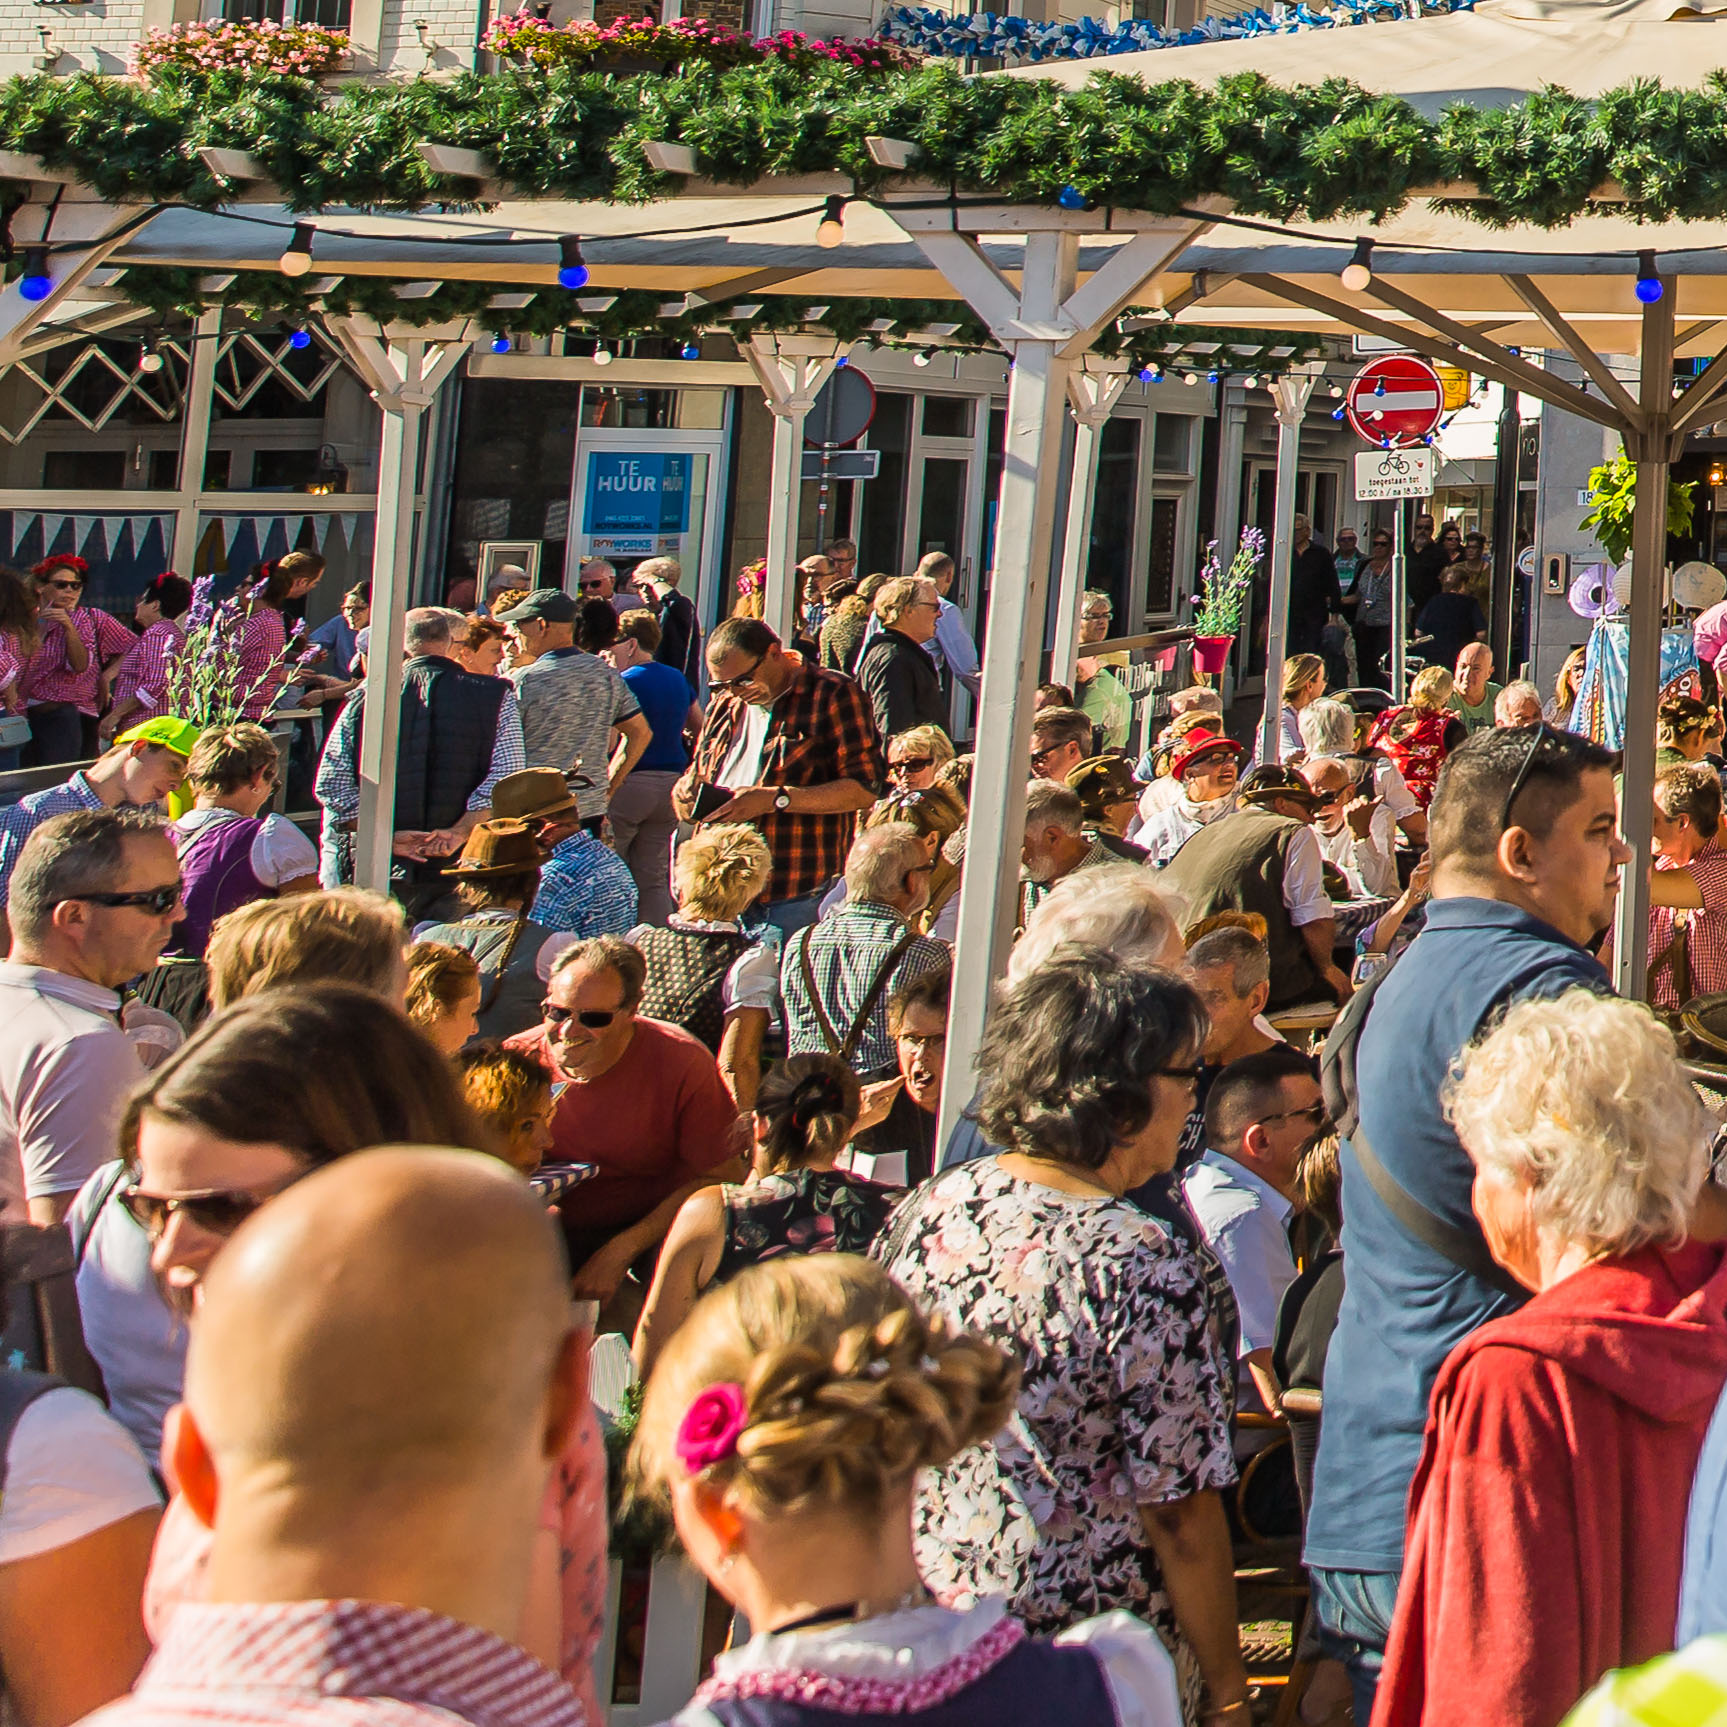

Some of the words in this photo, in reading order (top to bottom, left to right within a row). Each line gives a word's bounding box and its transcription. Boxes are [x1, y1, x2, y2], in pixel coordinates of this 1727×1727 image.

[618, 460, 641, 476] TE
[598, 476, 657, 492] HUUR
[1369, 477, 1407, 488] toegestaan
[1409, 475, 1420, 484] tot
